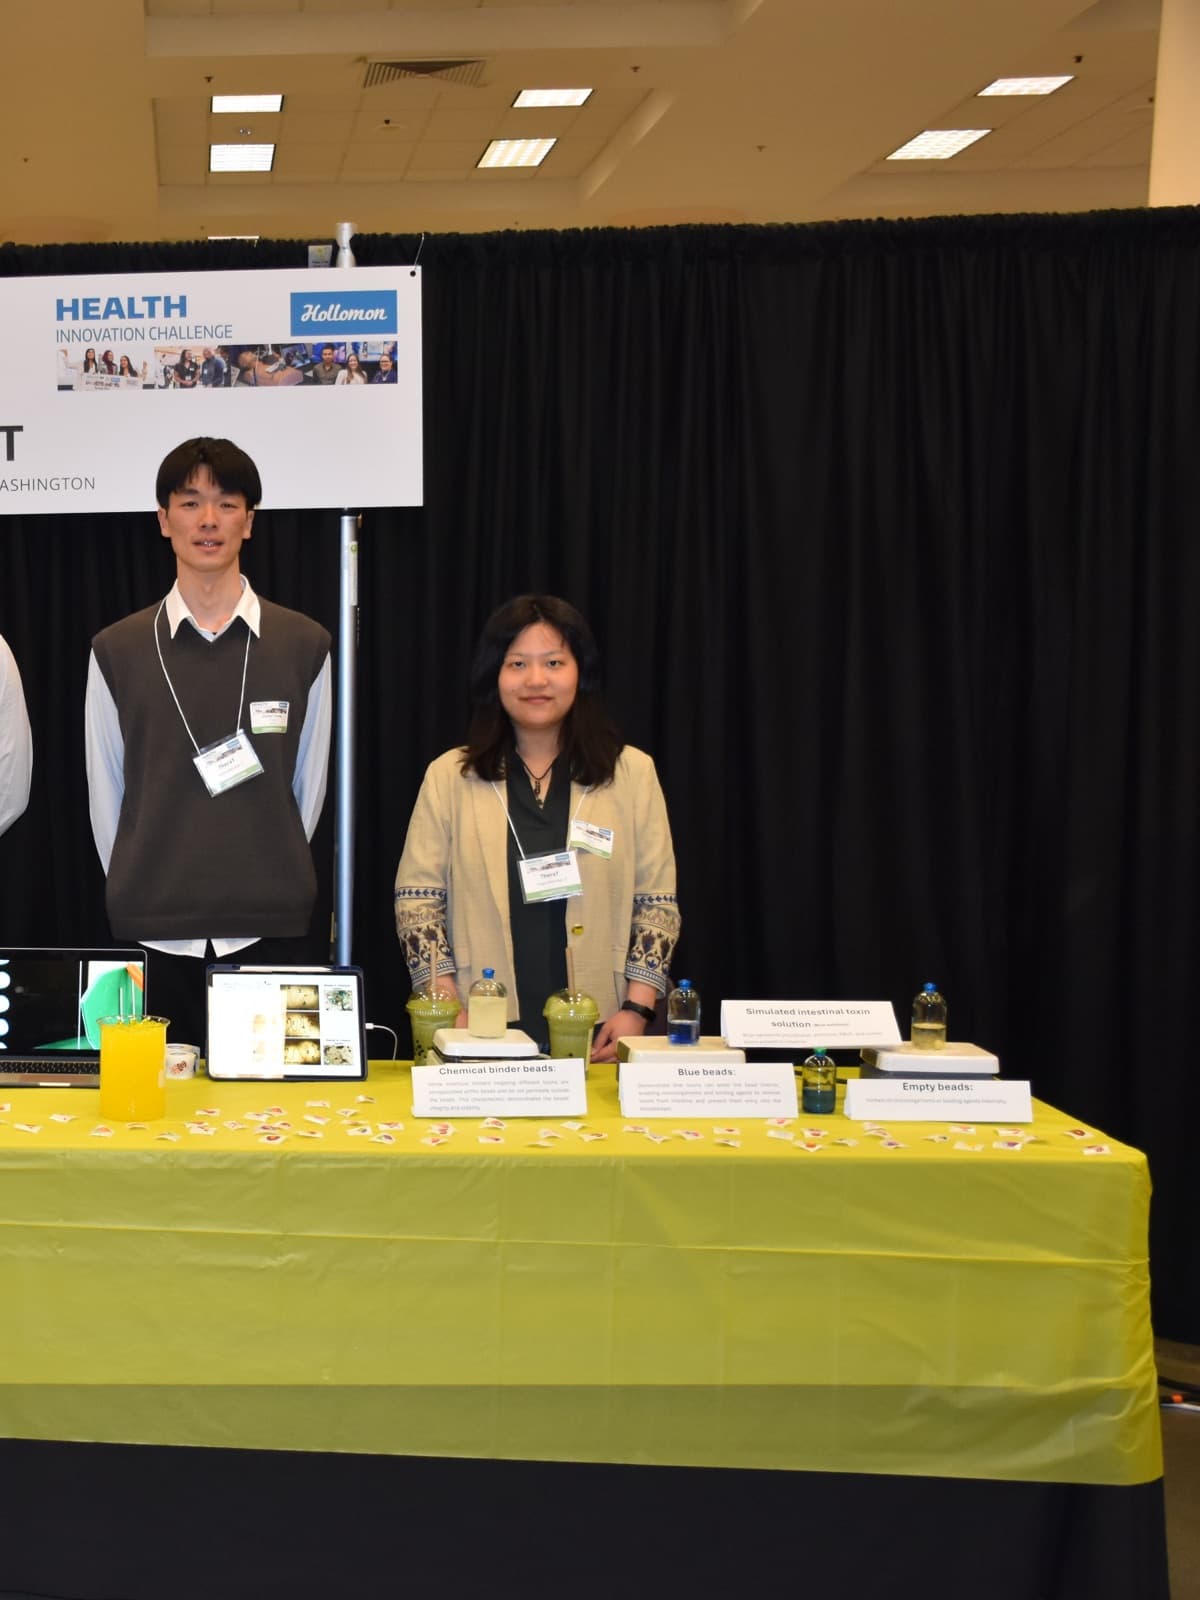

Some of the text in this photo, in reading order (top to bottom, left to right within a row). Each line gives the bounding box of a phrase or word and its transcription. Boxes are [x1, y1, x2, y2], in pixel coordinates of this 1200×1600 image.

[56, 295, 187, 321] HEALTH
[300, 303, 387, 324] Hollomon
[56, 324, 233, 342] INNOVATION CHALLENGE
[798, 1008, 844, 1016] intestinal
[771, 1020, 811, 1028] solution
[439, 1065, 556, 1075] Chemical binder beads:
[678, 1068, 736, 1076] Blue beads:
[903, 1082, 973, 1092] Empty beads:
